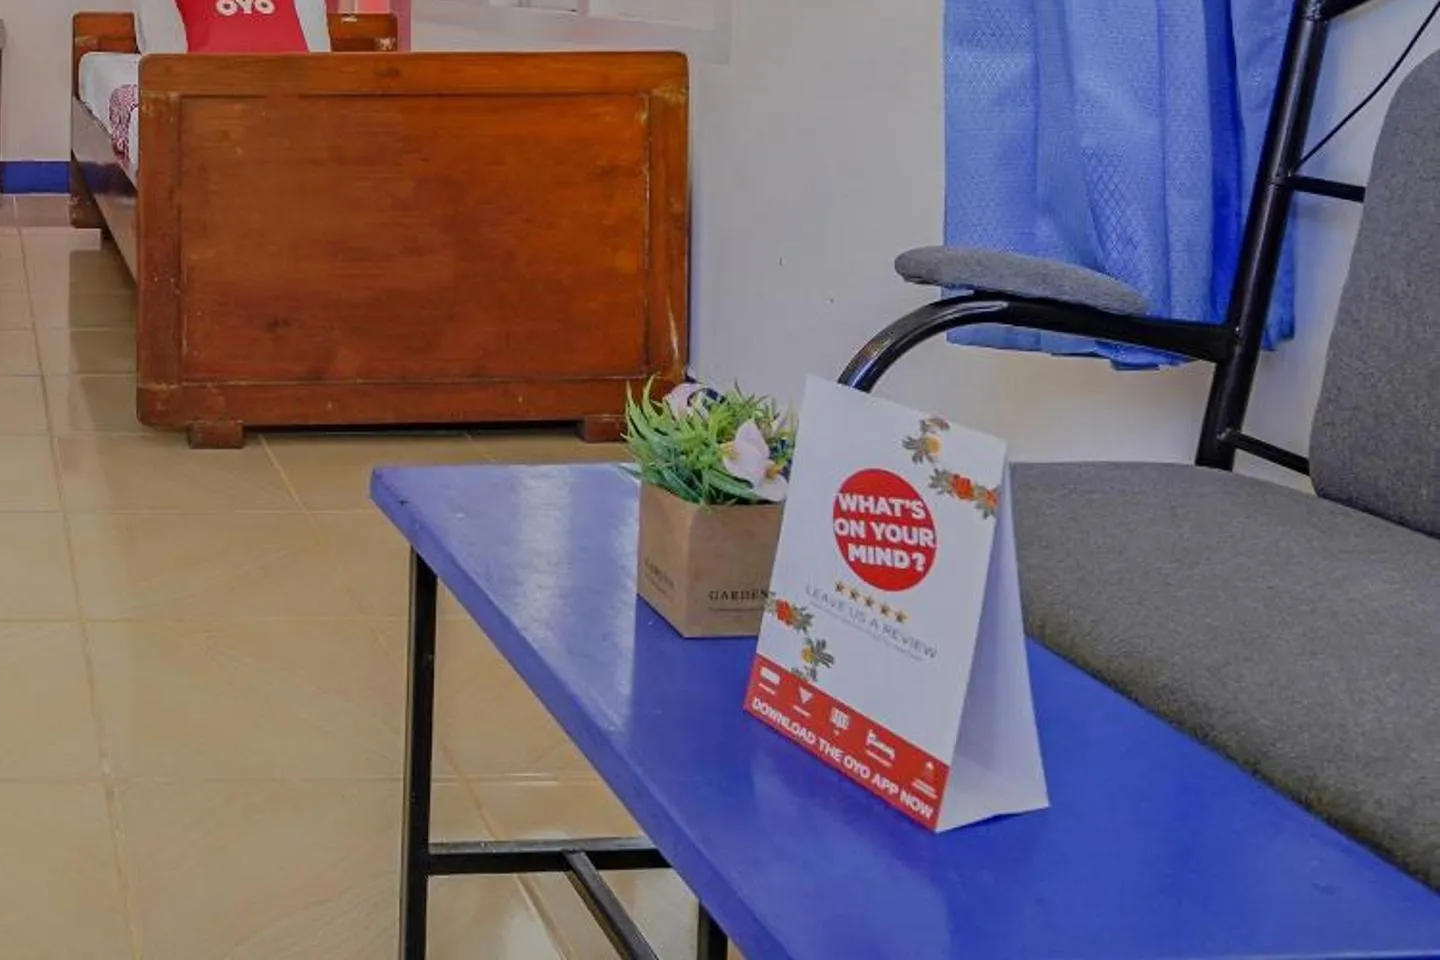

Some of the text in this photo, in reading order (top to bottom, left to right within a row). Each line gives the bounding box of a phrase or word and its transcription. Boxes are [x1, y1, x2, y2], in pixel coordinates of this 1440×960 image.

[837, 492, 926, 519] WHAT'S
[834, 518, 937, 548] ON YOUR
[848, 543, 926, 572] MIND?
[805, 583, 846, 612] LEAVE
[848, 605, 866, 623] US
[882, 622, 937, 659] REVIEW
[752, 697, 816, 745] DOWNLOAD
[818, 737, 843, 762] THE
[843, 755, 870, 780] OYO
[872, 773, 899, 795] APP
[900, 790, 933, 819] NOW
